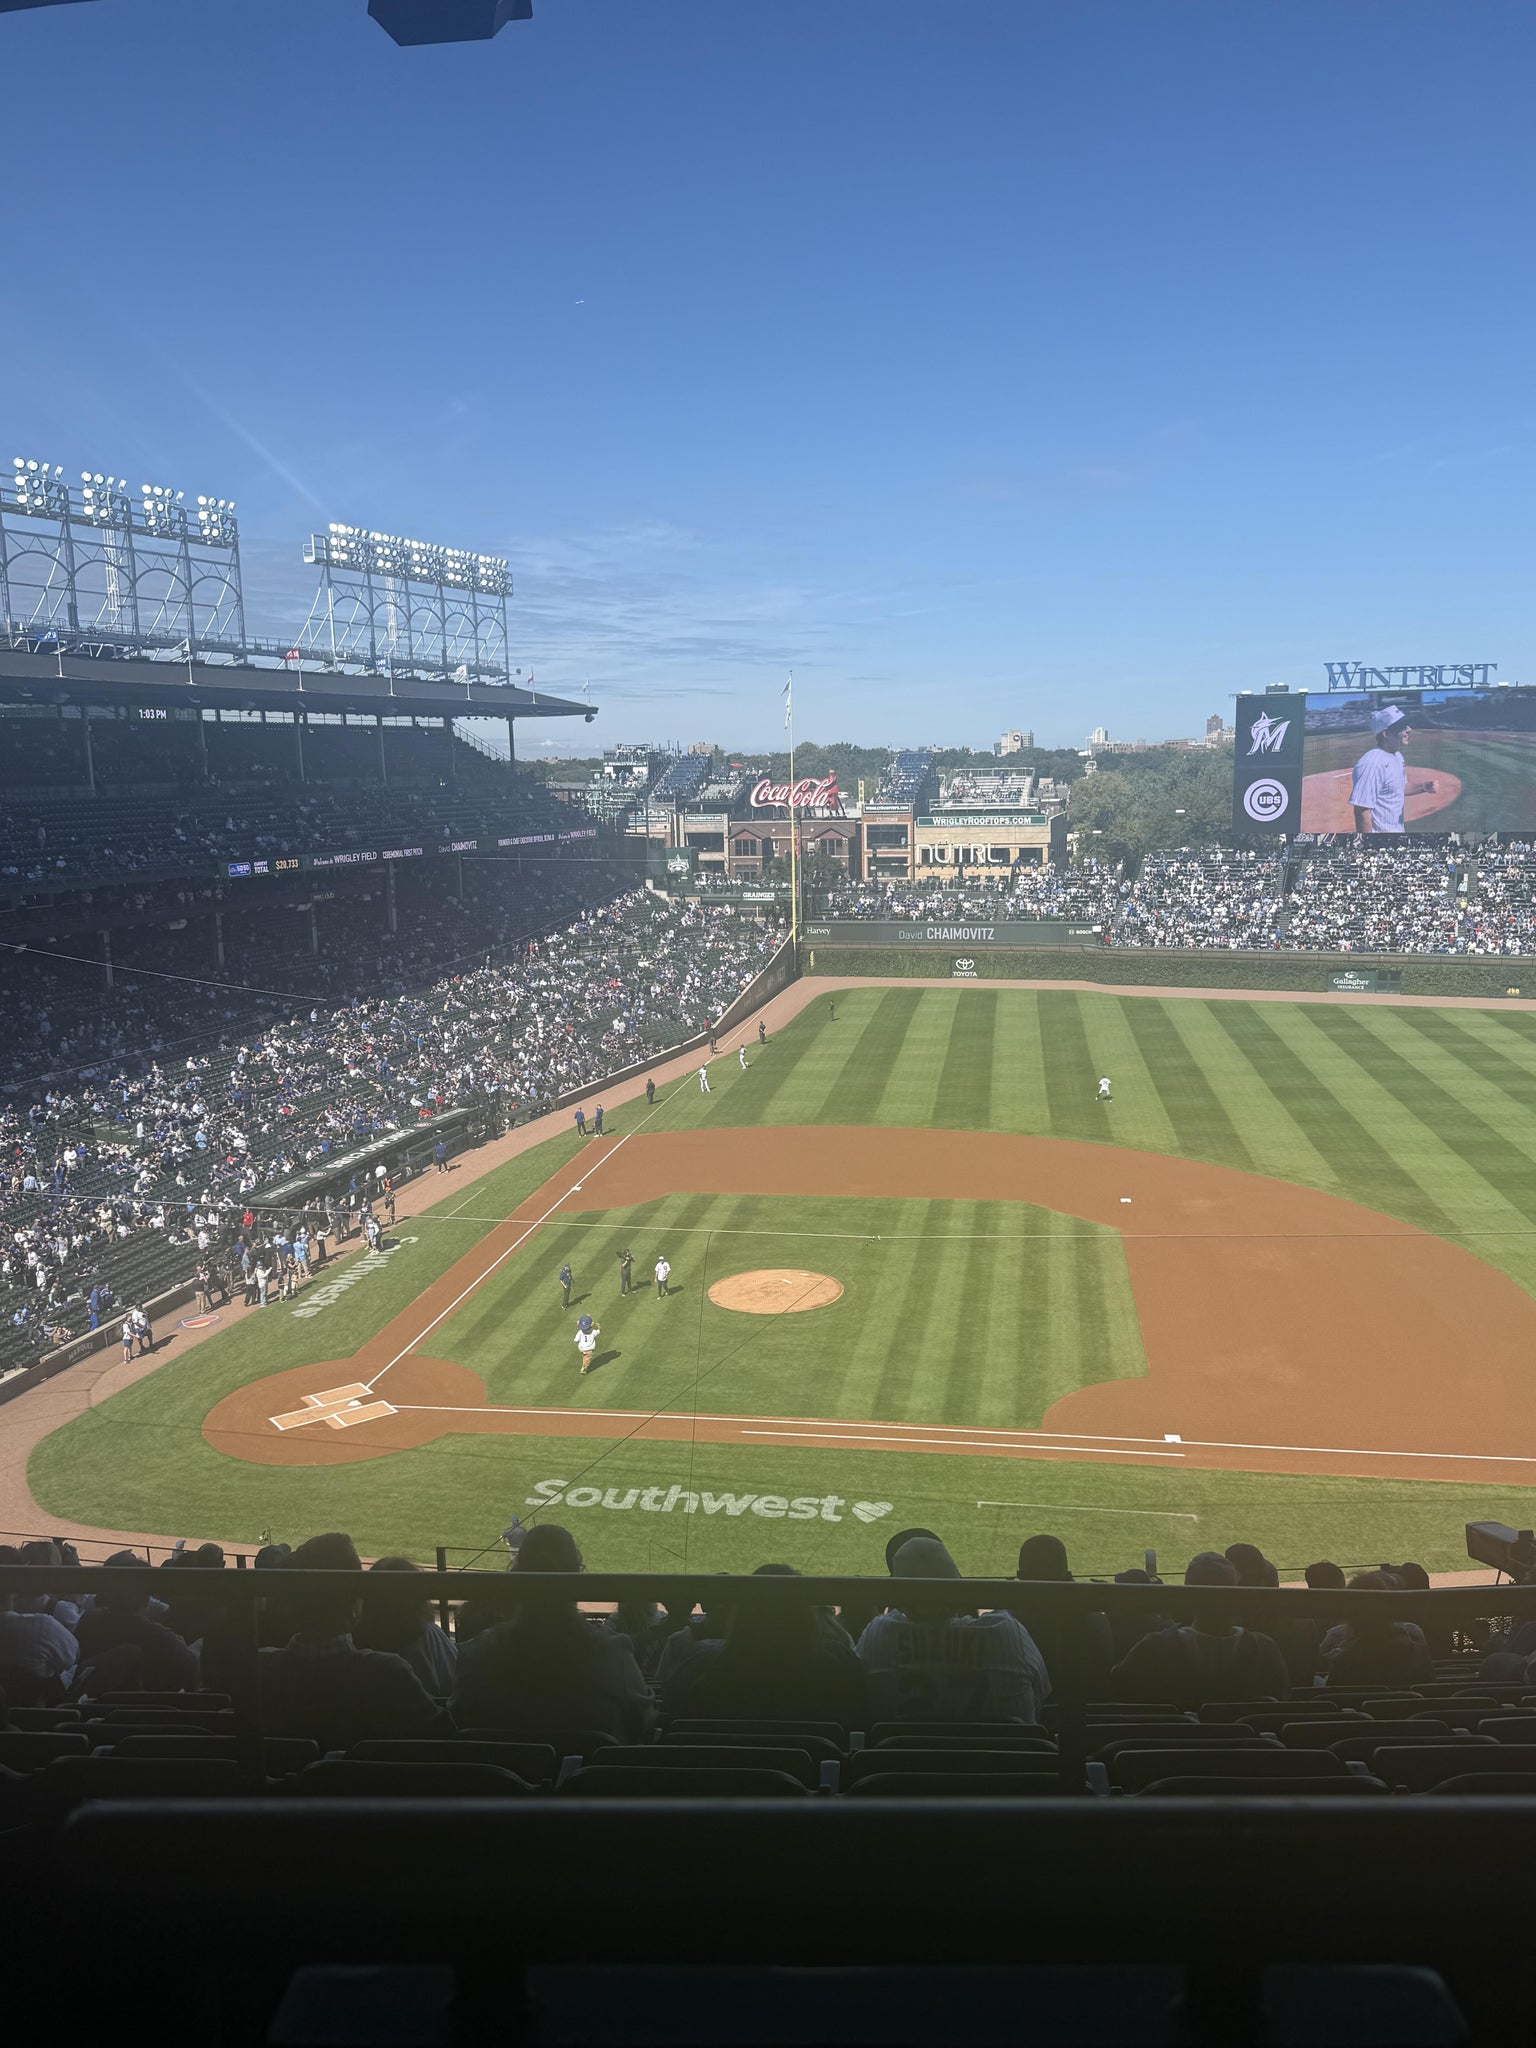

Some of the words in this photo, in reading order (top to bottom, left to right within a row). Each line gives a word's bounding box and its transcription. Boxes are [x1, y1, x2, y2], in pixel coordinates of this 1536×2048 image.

[1323, 661, 1498, 690] WINTRUST
[139, 709, 155, 719] 1:03
[156, 709, 167, 719] PM
[750, 778, 832, 808] CocaCola
[334, 852, 361, 863] WRIGLEY
[361, 851, 378, 861] FIELD
[275, 859, 299, 870] $20,733
[806, 926, 831, 936] Harvey
[898, 929, 923, 940] David
[926, 927, 995, 941] CHAIMOVITZ
[1333, 977, 1370, 986] Gallagher
[525, 1478, 845, 1522] Southwest
